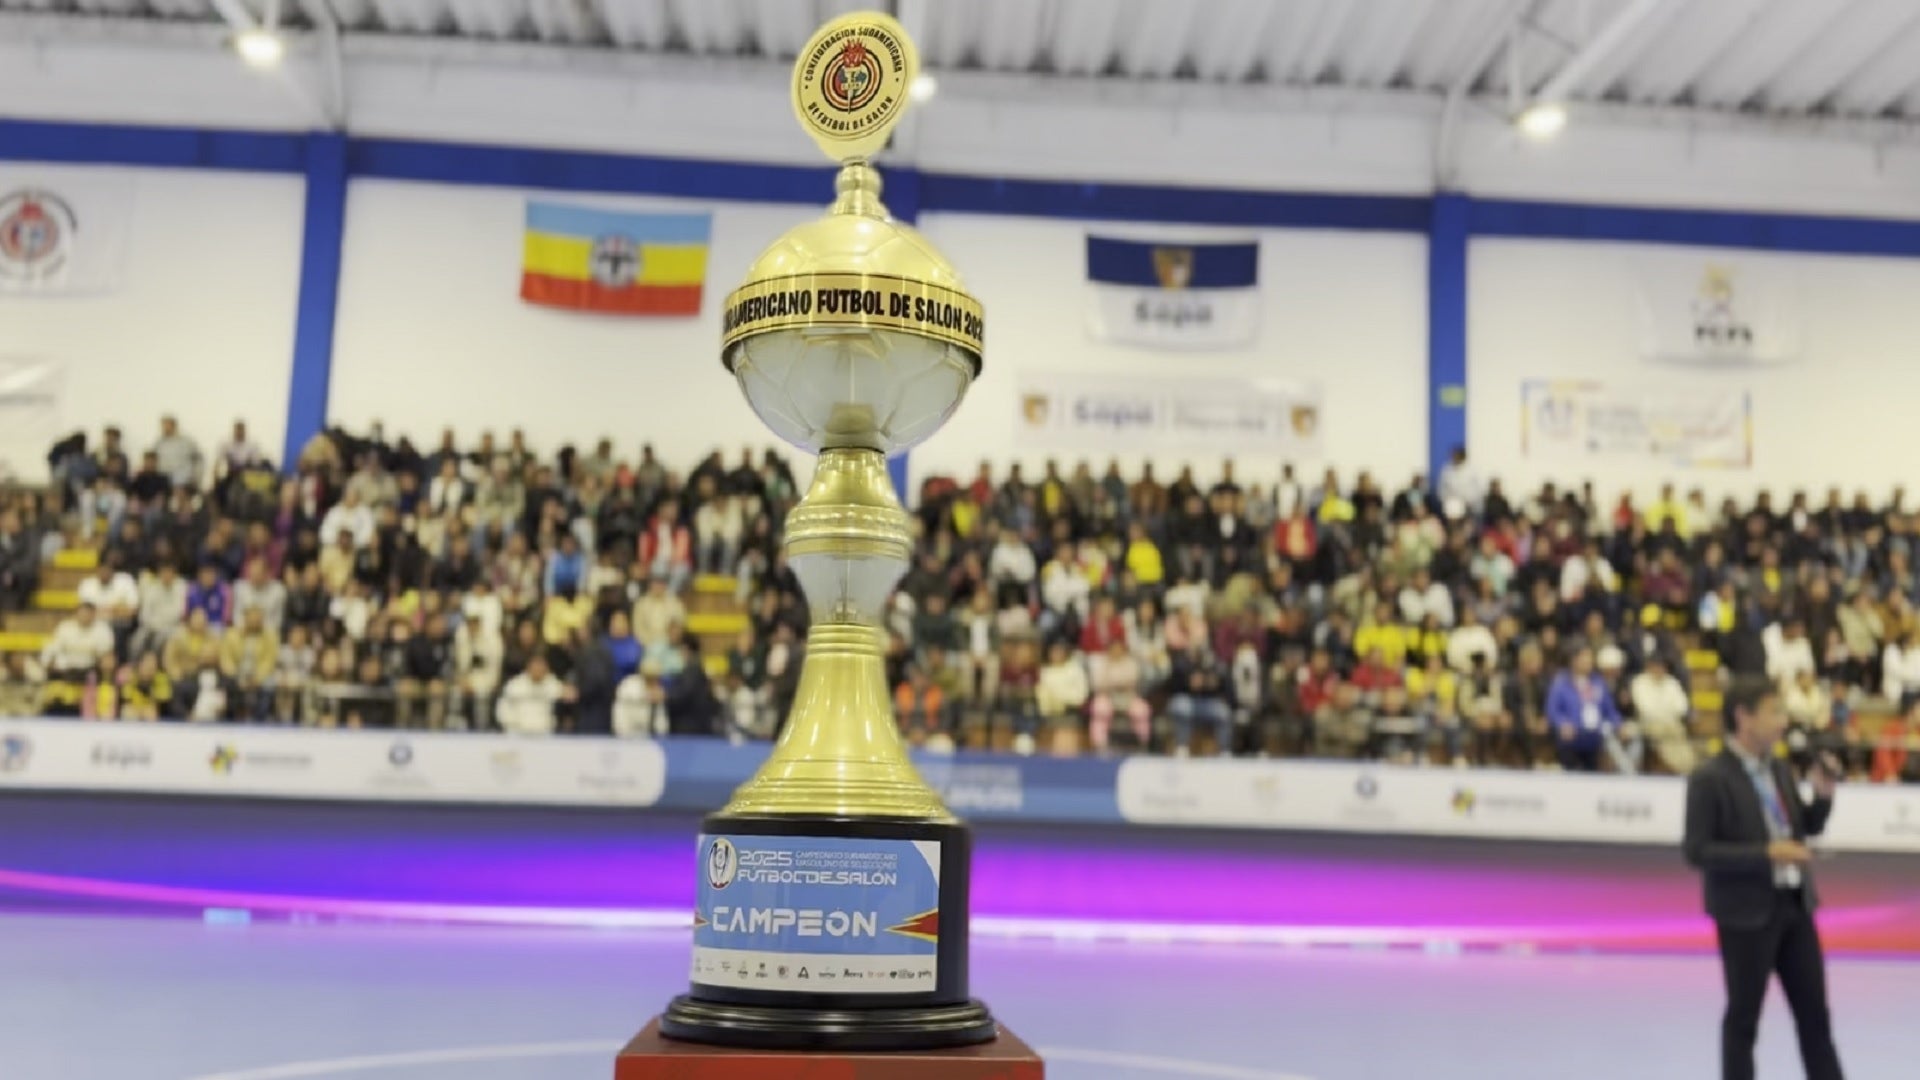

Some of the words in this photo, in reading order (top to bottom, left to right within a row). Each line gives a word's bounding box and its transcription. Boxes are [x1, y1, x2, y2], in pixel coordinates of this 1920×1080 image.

[858, 26, 903, 73] SUDAMERICANA
[889, 293, 910, 319] DE
[964, 310, 983, 341] 202
[739, 850, 793, 867] 2025
